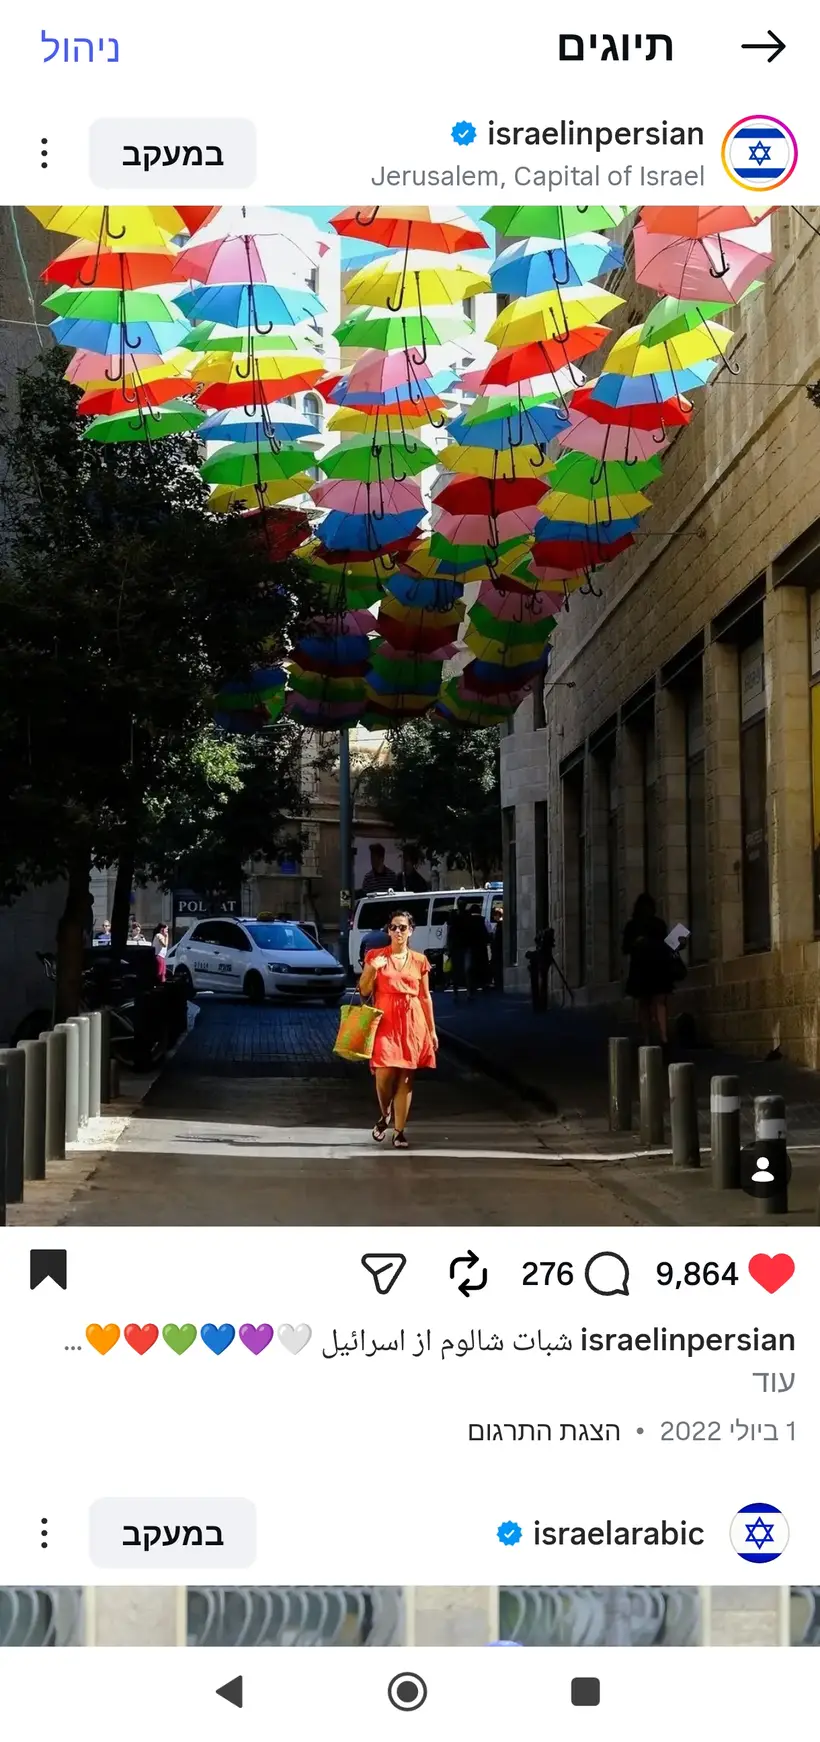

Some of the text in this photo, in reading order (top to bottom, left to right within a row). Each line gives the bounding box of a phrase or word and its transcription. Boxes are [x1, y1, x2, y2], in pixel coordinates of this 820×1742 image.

[41, 30, 120, 63] ניהול
[558, 33, 673, 62] תיוגים
[488, 119, 704, 152] israelinpersian
[121, 145, 225, 172] במעקב
[371, 164, 705, 192] Jerusalem, Capital of Israel
[178, 900, 237, 912] POLAT
[522, 1261, 574, 1286] 276
[656, 1261, 739, 1290] 9,864
[411, 1328, 431, 1358] از
[441, 1328, 504, 1360] شالوم
[513, 1329, 573, 1357] شبات
[581, 1327, 795, 1358] israelinpersian
[751, 1372, 796, 1393] עוד
[468, 1423, 621, 1442] הצגת התרגום
[660, 1417, 796, 1442] 1 ביולי 2022
[122, 1525, 225, 1553] במעקב
[533, 1519, 705, 1546] israelarabic
